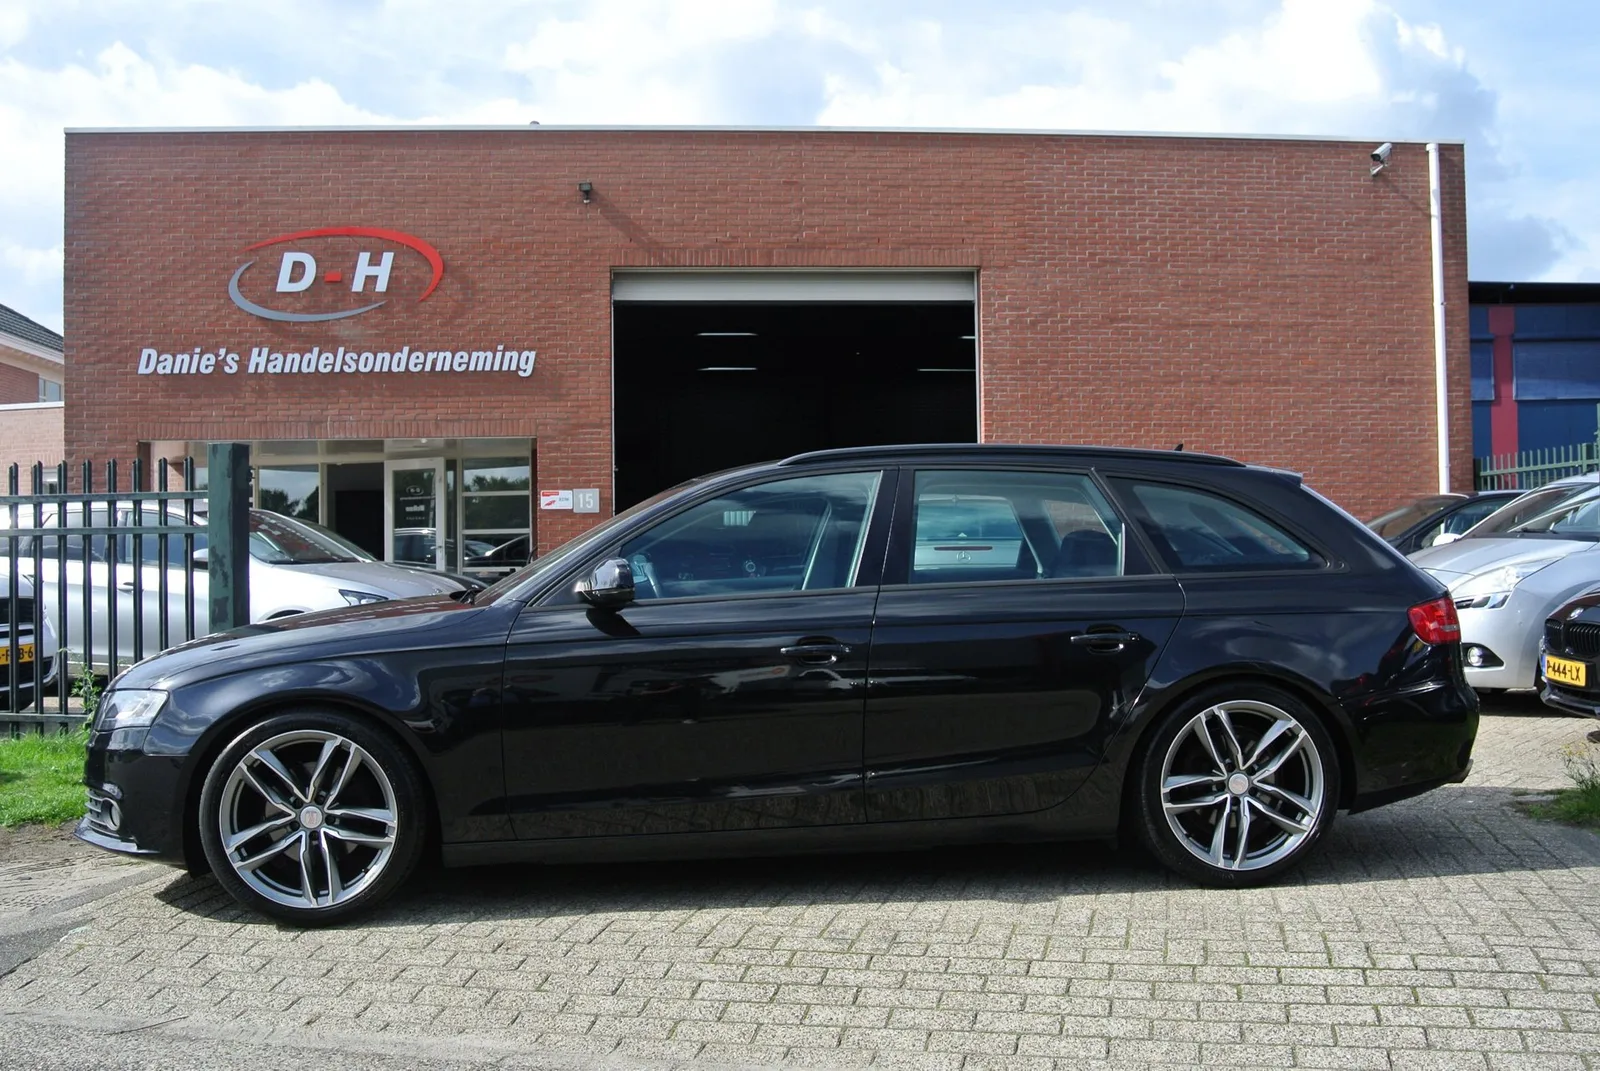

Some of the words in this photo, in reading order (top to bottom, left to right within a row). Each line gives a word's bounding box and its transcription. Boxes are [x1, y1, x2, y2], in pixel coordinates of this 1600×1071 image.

[138, 347, 239, 375] Danie's
[247, 344, 536, 377] Handelsonderneming
[578, 493, 594, 509] 15
